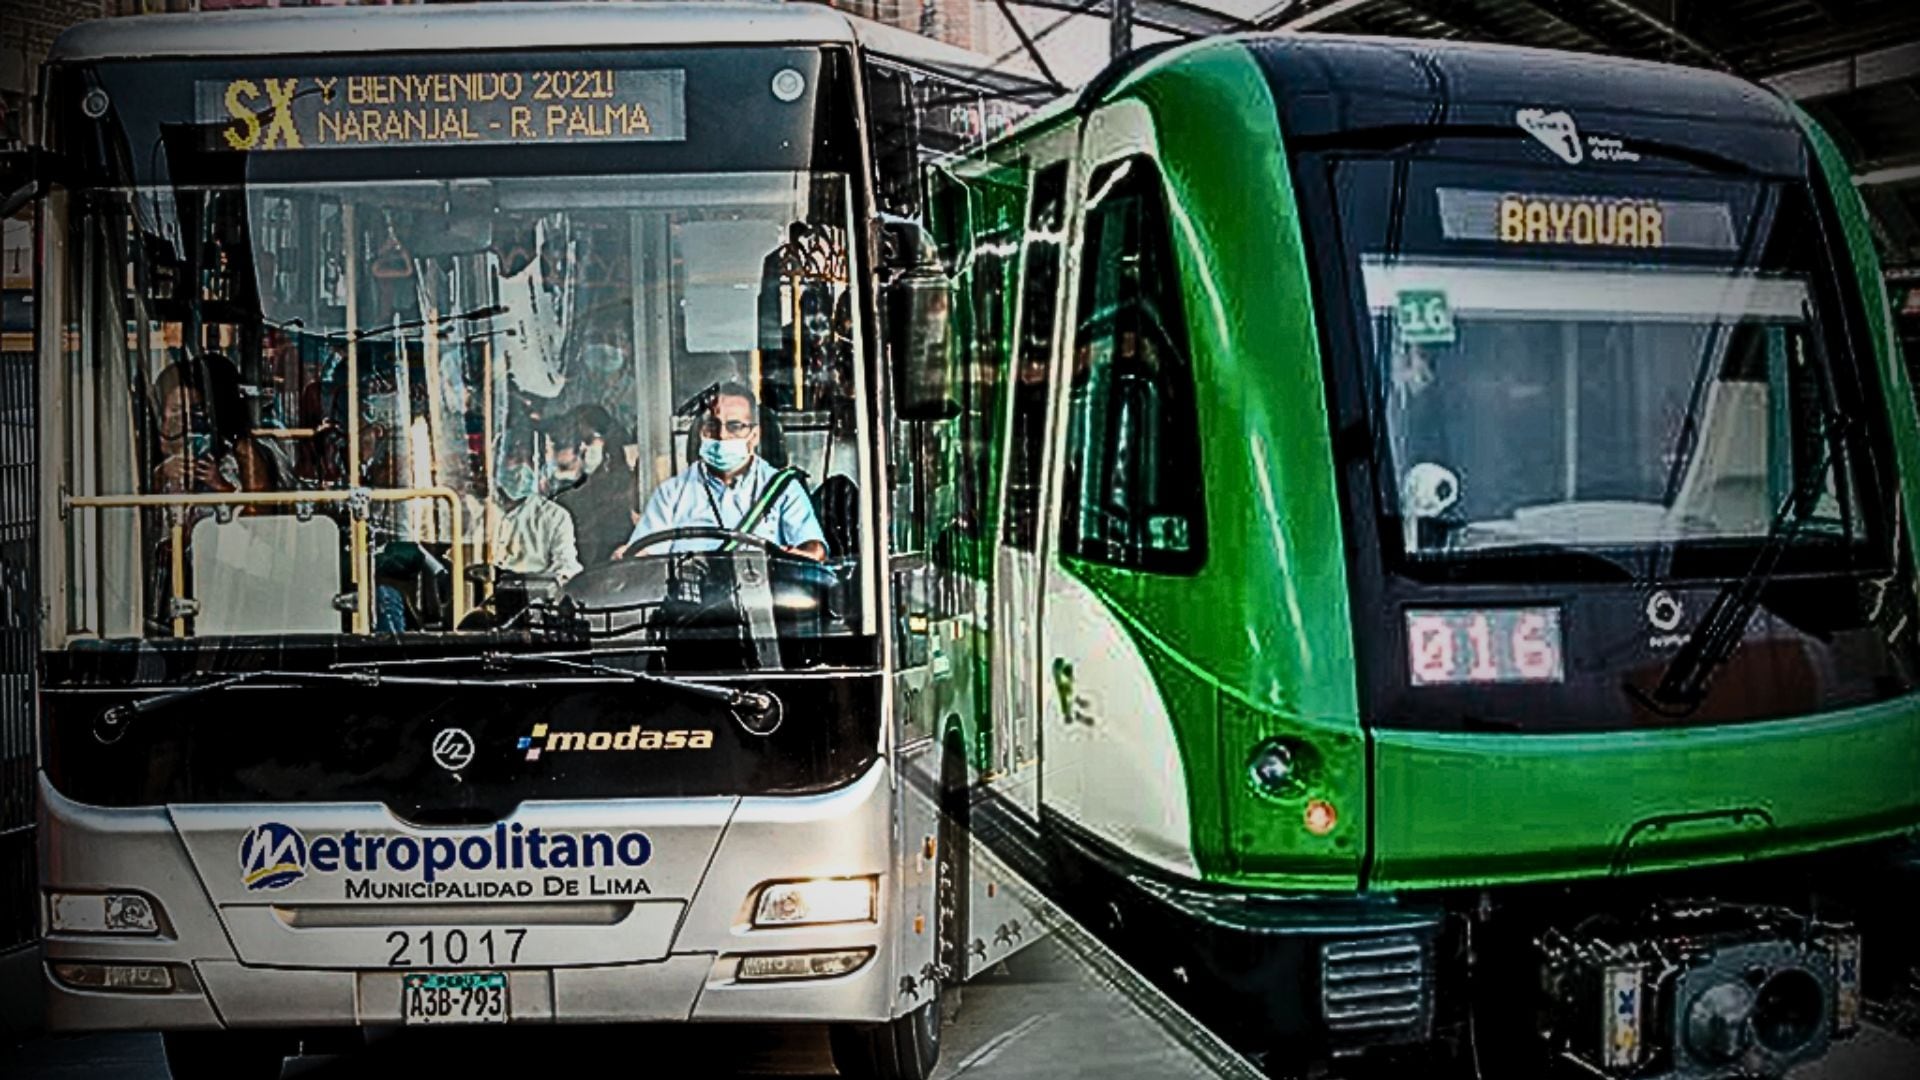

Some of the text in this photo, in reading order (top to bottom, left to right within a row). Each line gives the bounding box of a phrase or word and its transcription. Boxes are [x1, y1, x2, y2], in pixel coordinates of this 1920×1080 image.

[314, 69, 616, 106] Y BIENVENIDO 2021!
[222, 78, 304, 151] SX
[317, 102, 650, 144] NARANJAL - R. PALMA
[545, 725, 713, 751] modasa
[239, 822, 653, 890] Metropolitano
[385, 928, 528, 966] 21017
[409, 986, 502, 1017] A3B-793
